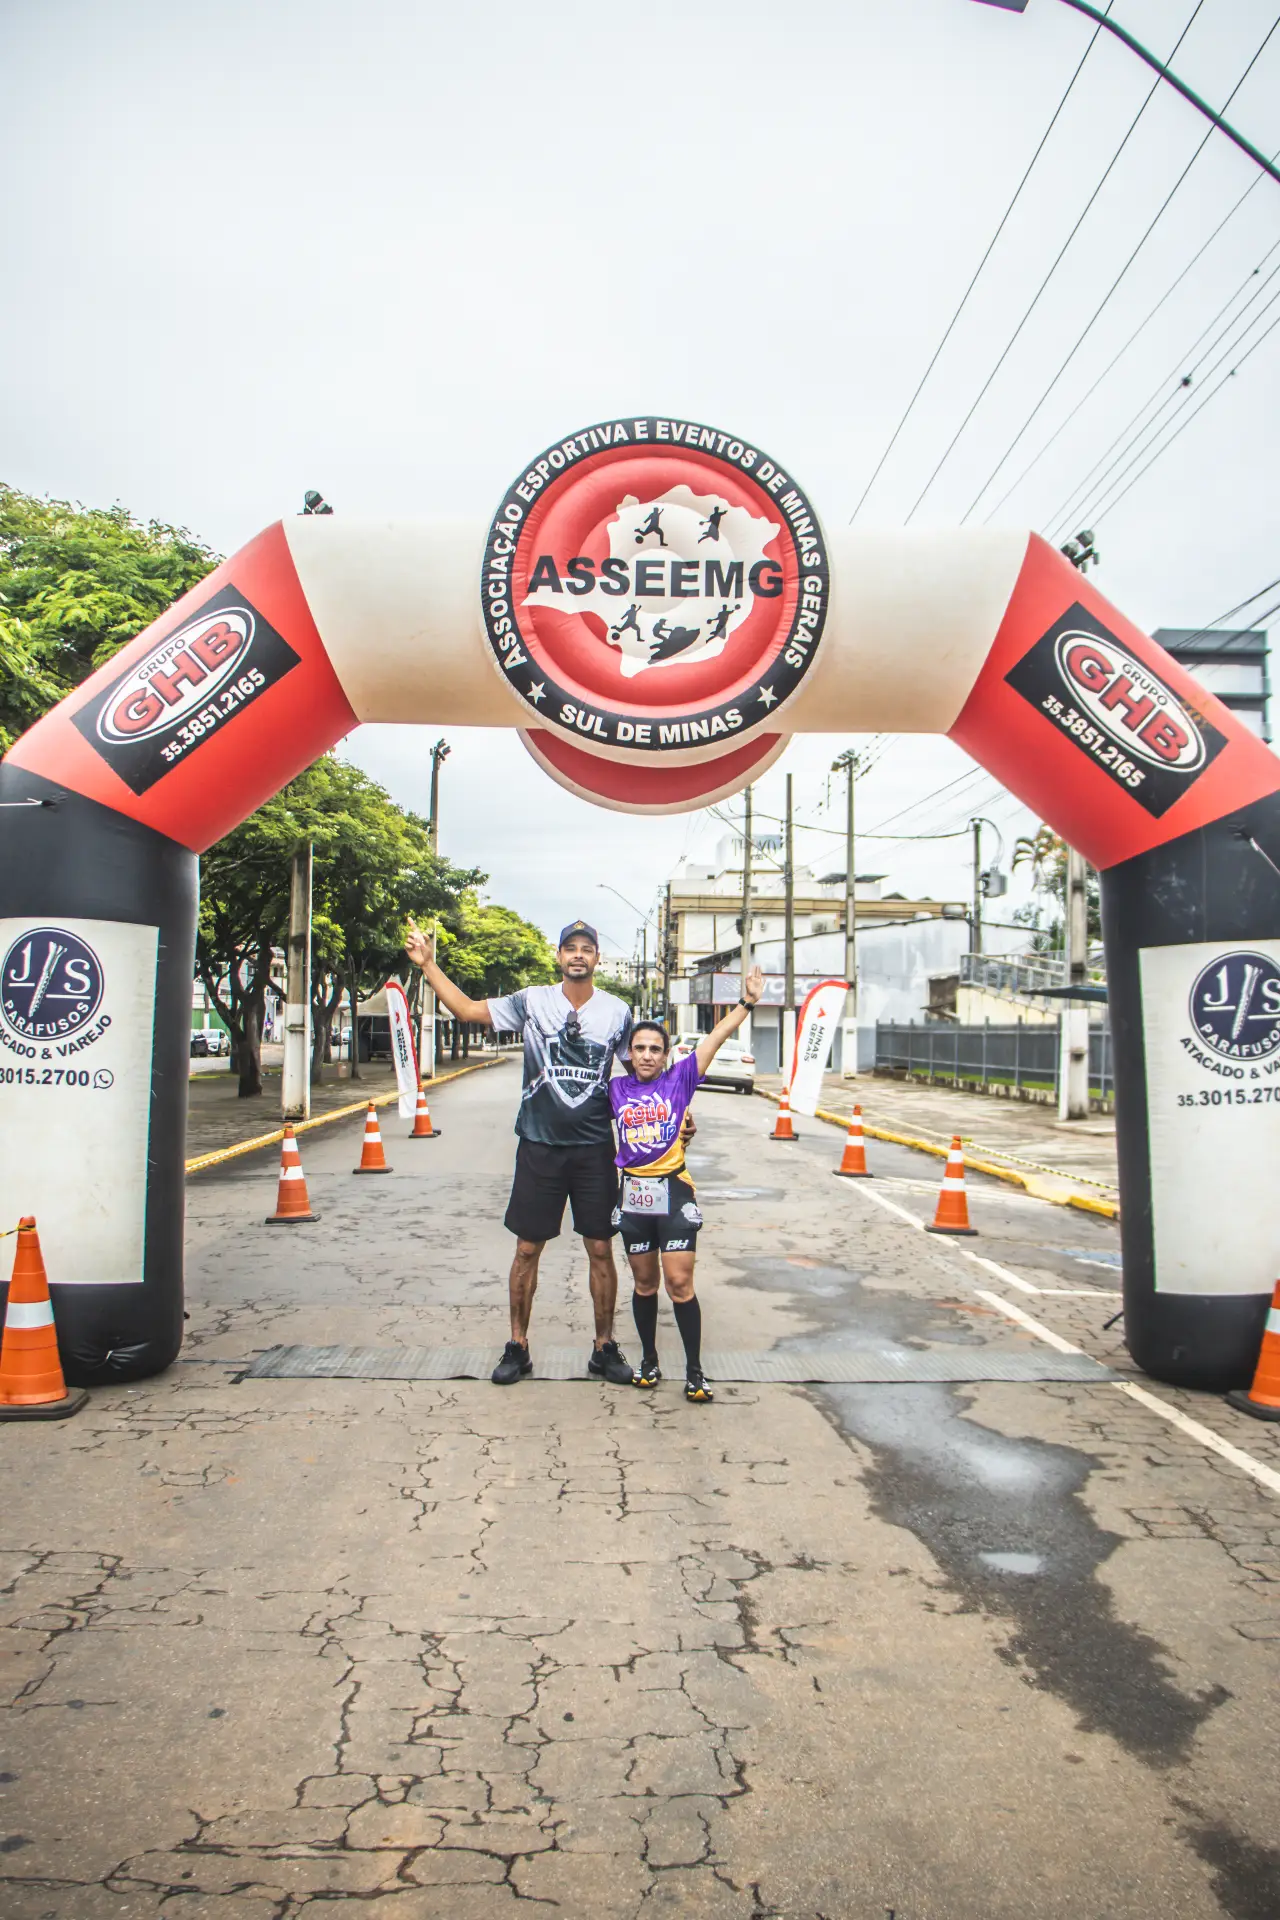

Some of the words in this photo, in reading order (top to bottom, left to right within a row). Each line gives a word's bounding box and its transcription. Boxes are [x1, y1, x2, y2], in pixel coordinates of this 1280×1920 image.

[634, 421, 649, 439] E
[656, 421, 758, 469] EVENTOS
[516, 423, 628, 503] ESPORTIVA
[755, 461, 788, 493] DE
[780, 491, 821, 568] MINAS
[488, 503, 527, 670] ASSOCIAÇÃO
[526, 555, 784, 599] ASSEEMG
[785, 575, 823, 669] GERAIS
[113, 621, 244, 734] GHB
[138, 638, 186, 681] GRUPO
[1068, 644, 1189, 762] GHB
[1122, 662, 1168, 706] GRUPO
[160, 668, 266, 762] 35.3851.2165
[559, 703, 608, 738] SUL
[616, 722, 652, 744] DE
[659, 708, 743, 744] MINAS
[1041, 695, 1146, 788] 35.3851.2165
[4, 1000, 89, 1036] PARAFUSOS
[41, 1048, 52, 1059] &
[56, 1015, 112, 1057] VAREJO
[804, 1023, 818, 1062] GERAIS
[810, 1024, 825, 1060] MINAS
[1180, 1037, 1244, 1079] ATACADO
[1249, 1067, 1260, 1079] &
[629, 1193, 653, 1207] 349
